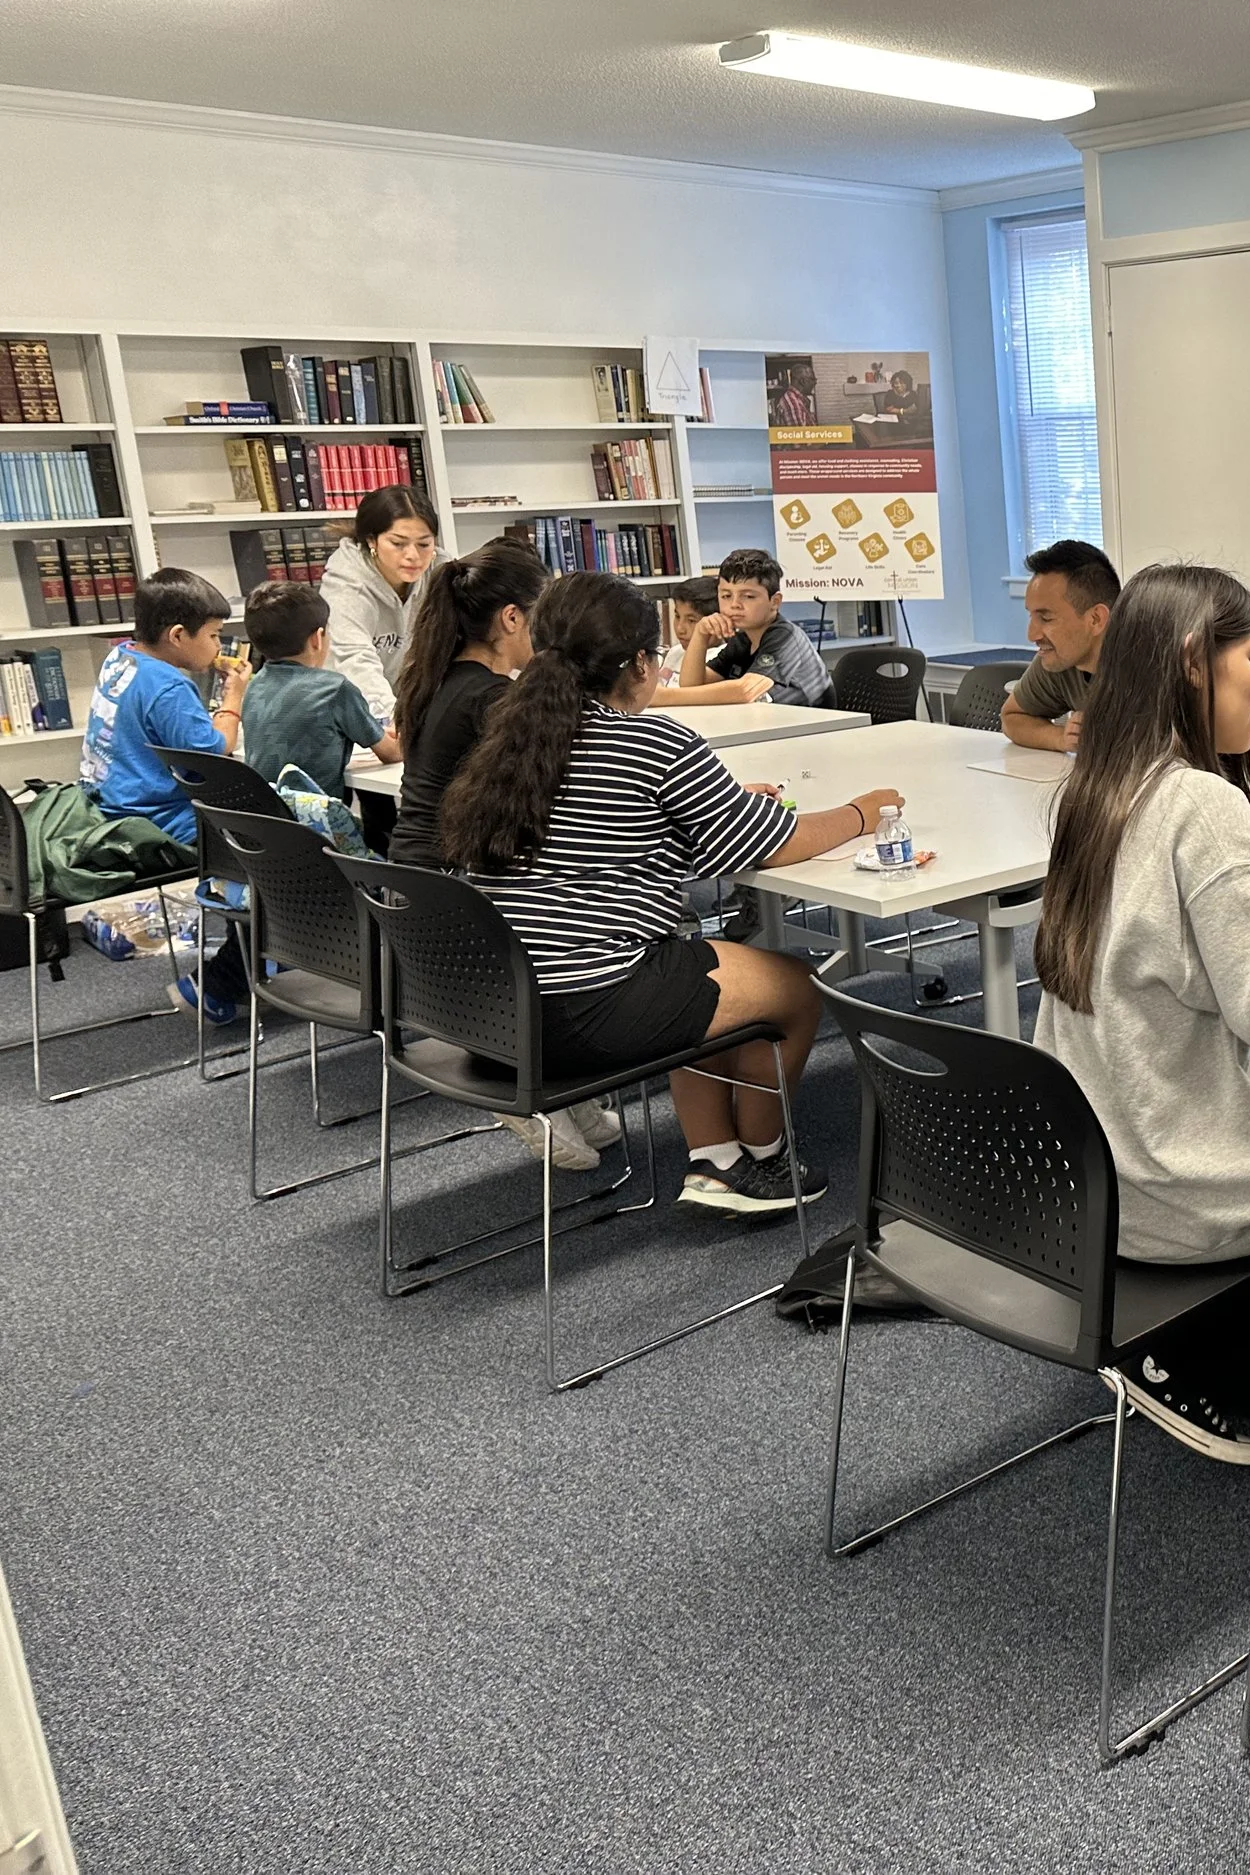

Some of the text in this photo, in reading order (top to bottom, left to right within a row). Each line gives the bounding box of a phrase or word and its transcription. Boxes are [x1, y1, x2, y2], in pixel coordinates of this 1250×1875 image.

[777, 430, 843, 440] Social Services
[785, 577, 864, 589] Mission: NOVA
